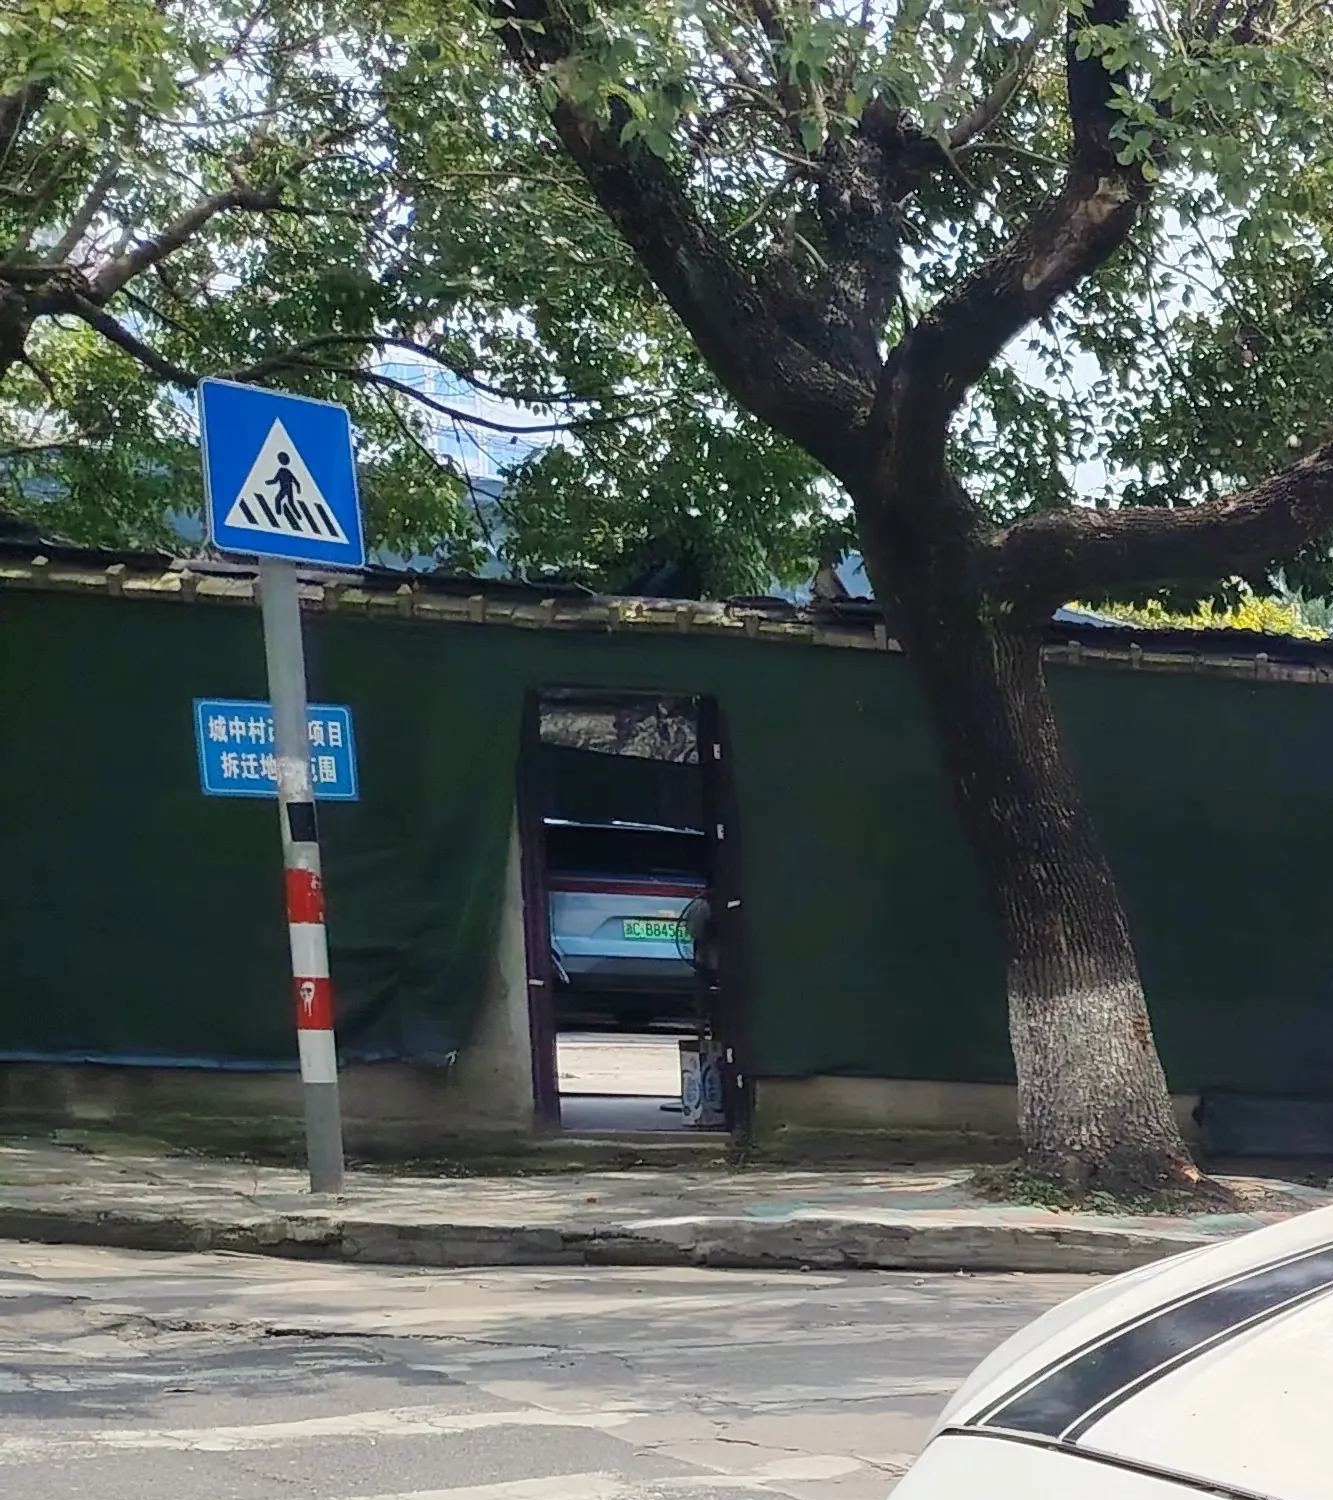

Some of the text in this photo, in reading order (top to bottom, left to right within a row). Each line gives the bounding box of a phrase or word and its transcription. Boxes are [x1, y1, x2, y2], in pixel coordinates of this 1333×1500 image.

[208, 715, 343, 747] 城中村项目
[220, 750, 337, 783] 拆迁地围
